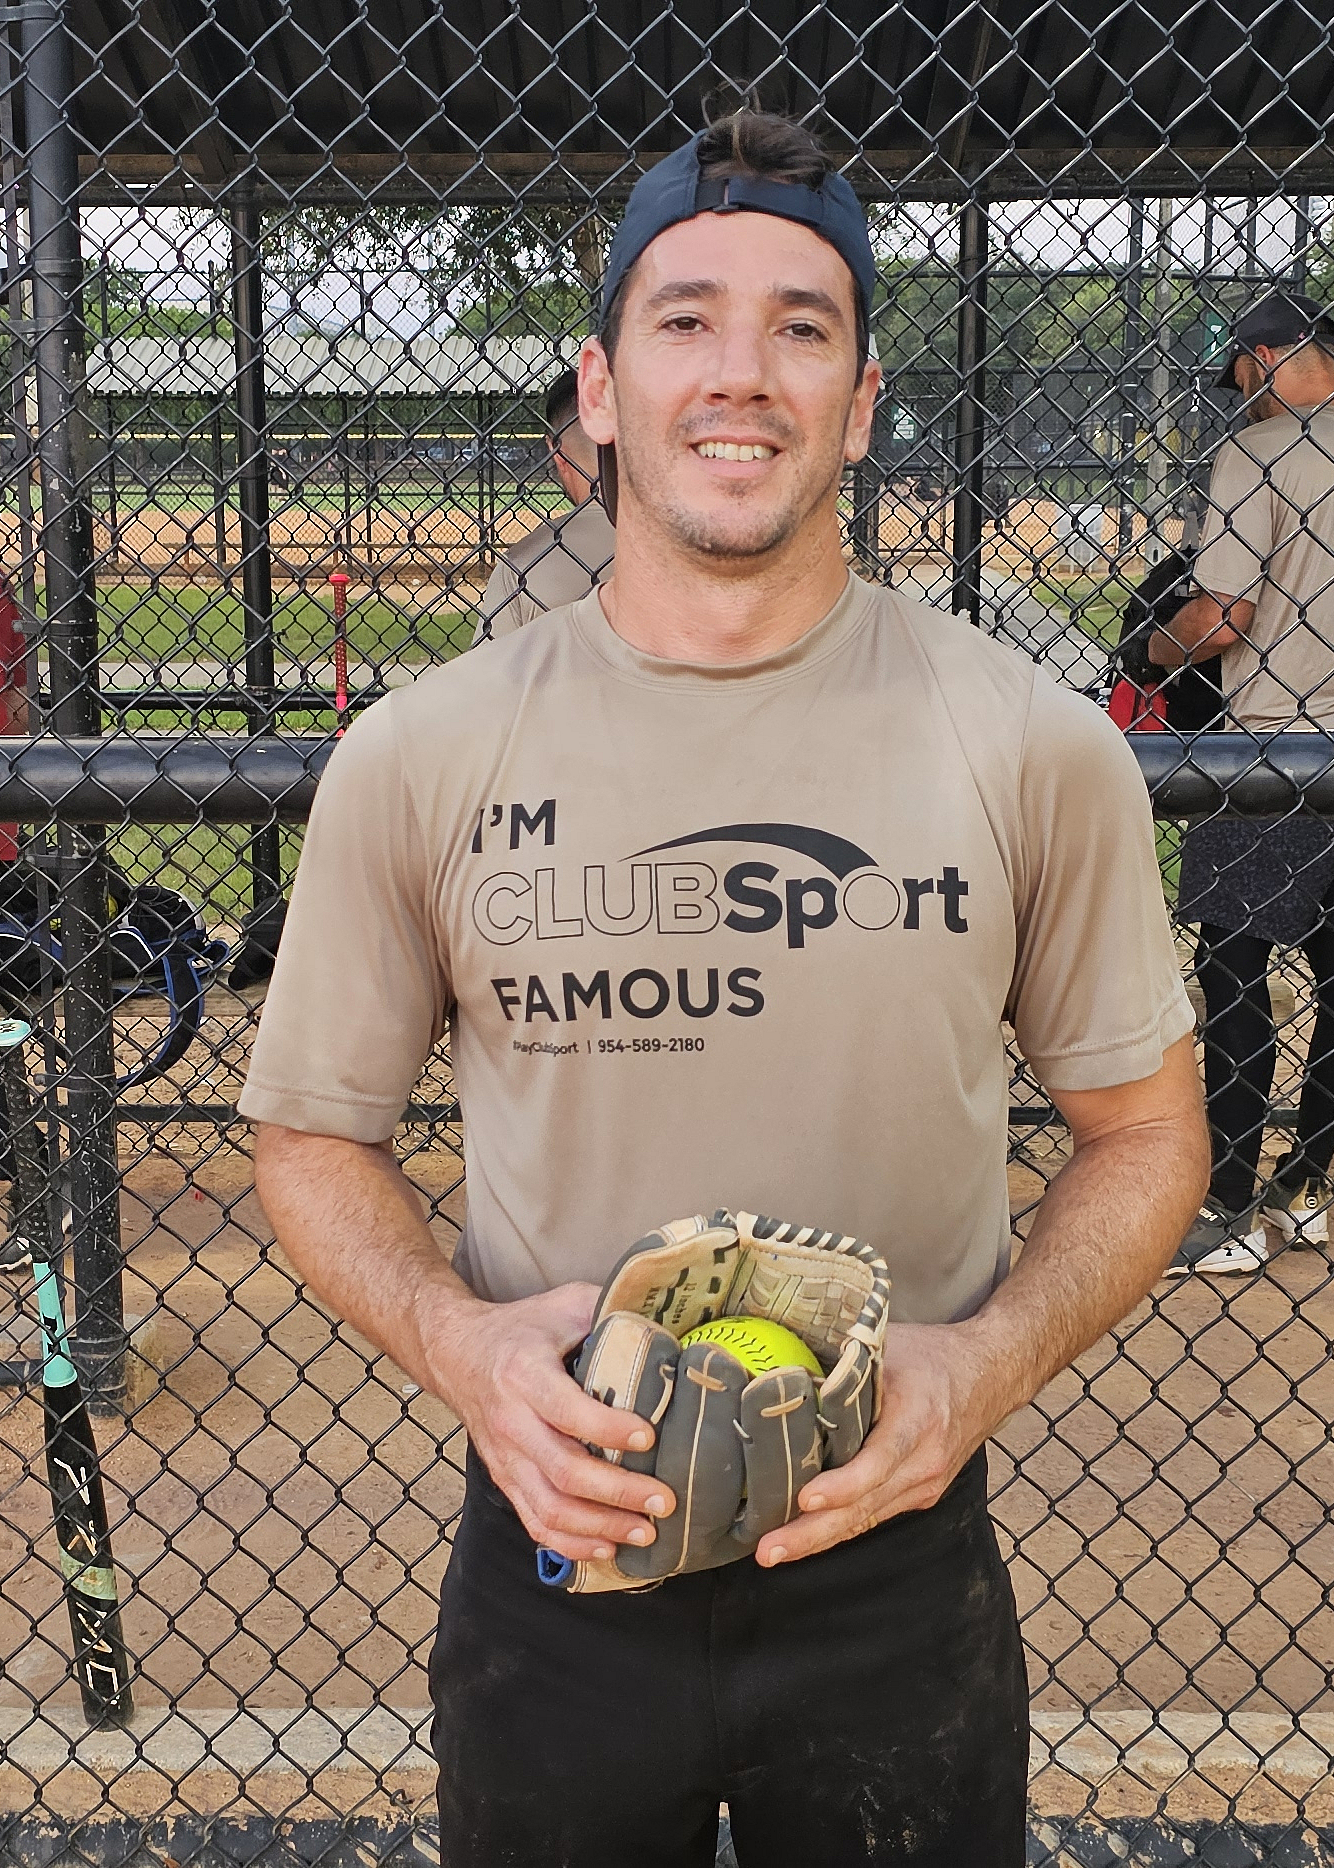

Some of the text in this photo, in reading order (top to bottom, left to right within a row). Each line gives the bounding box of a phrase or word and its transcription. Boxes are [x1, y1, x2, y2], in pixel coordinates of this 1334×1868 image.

[471, 799, 556, 853] I'M
[471, 861, 970, 949] CLUBSport
[490, 967, 765, 1022] FAMOUS
[597, 1037, 705, 1053] 954-589-2180
